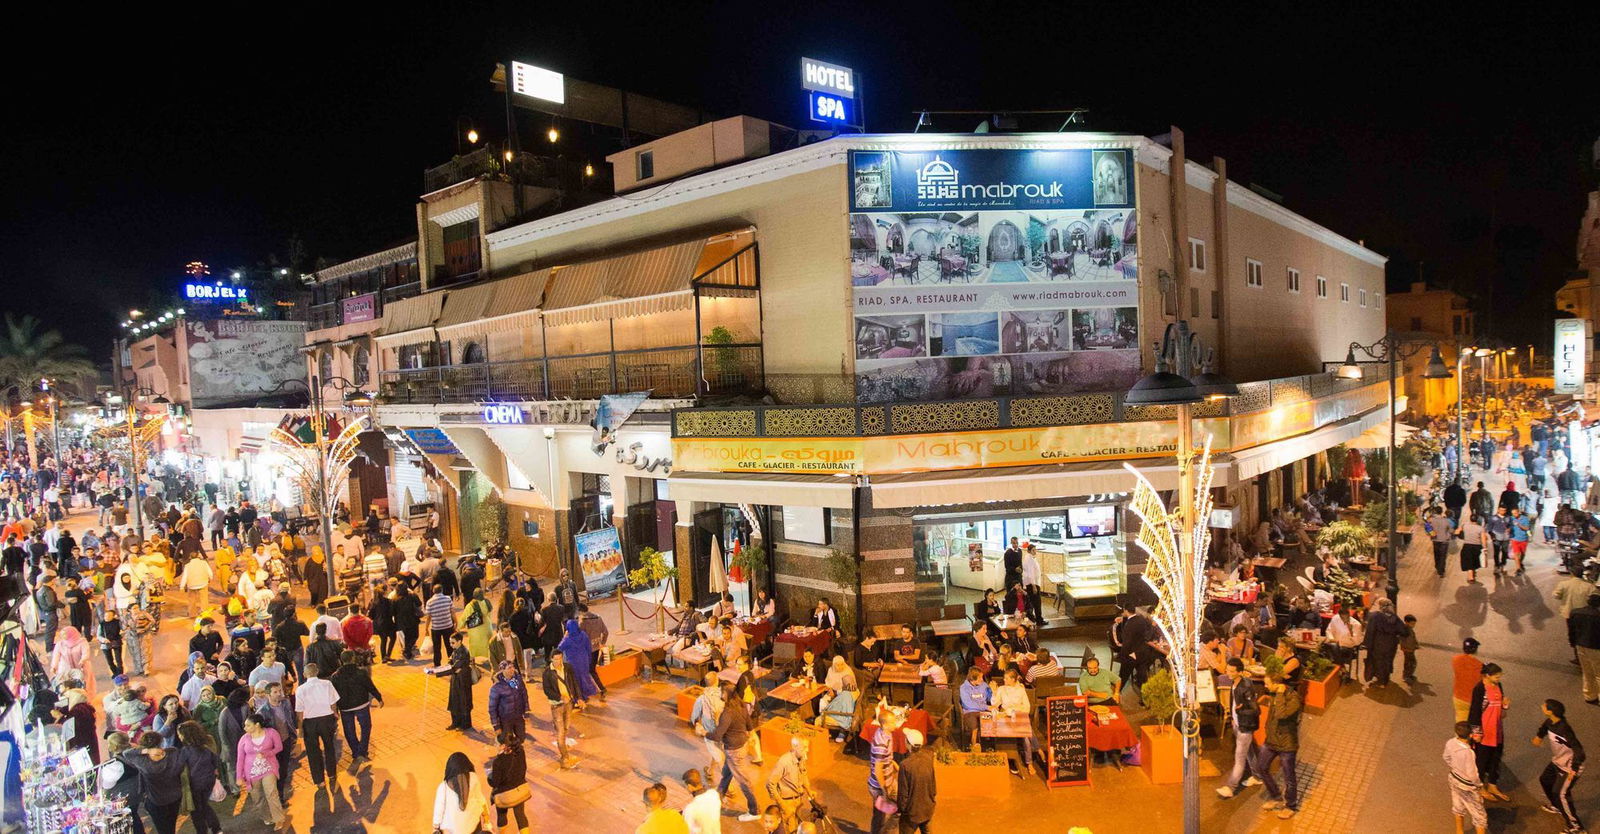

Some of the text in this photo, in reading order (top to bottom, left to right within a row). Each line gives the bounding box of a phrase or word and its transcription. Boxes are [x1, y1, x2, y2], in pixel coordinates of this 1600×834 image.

[806, 63, 854, 92] HOTEL
[817, 96, 846, 120] SPA
[961, 181, 1064, 199] mabrouk
[186, 284, 247, 298] BORJ EL K
[1012, 289, 1127, 301] www.riadmabrouk.com
[858, 293, 978, 306] RIAD, SPA, RESTAURANT
[484, 405, 523, 424] CINEMA
[738, 461, 758, 469] CAFE
[763, 461, 796, 470] GLACIER
[801, 462, 856, 470] RESTAURANT
